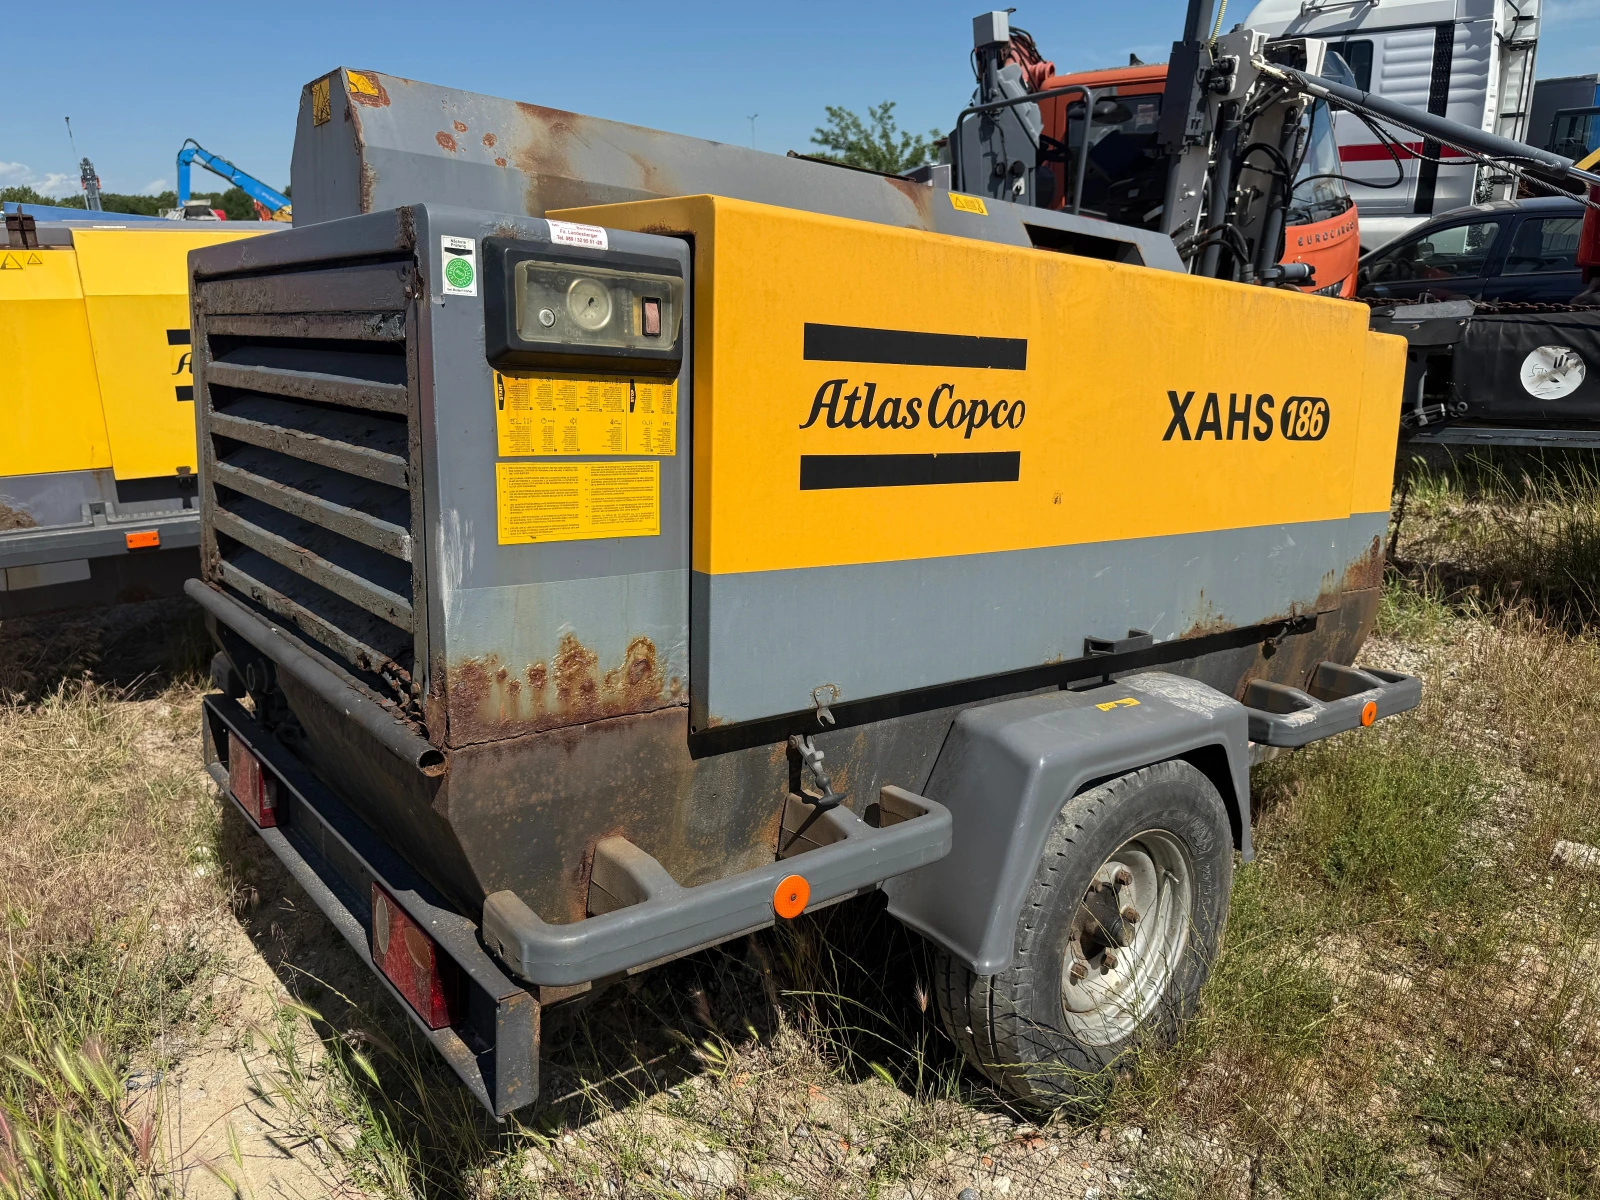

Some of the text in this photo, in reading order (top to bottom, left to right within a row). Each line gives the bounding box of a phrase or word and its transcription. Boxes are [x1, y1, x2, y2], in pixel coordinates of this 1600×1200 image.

[1297, 221, 1354, 247] EUROCARGO
[799, 378, 1026, 439] Atlas Copco
[1161, 390, 1327, 442] XAHS 186
